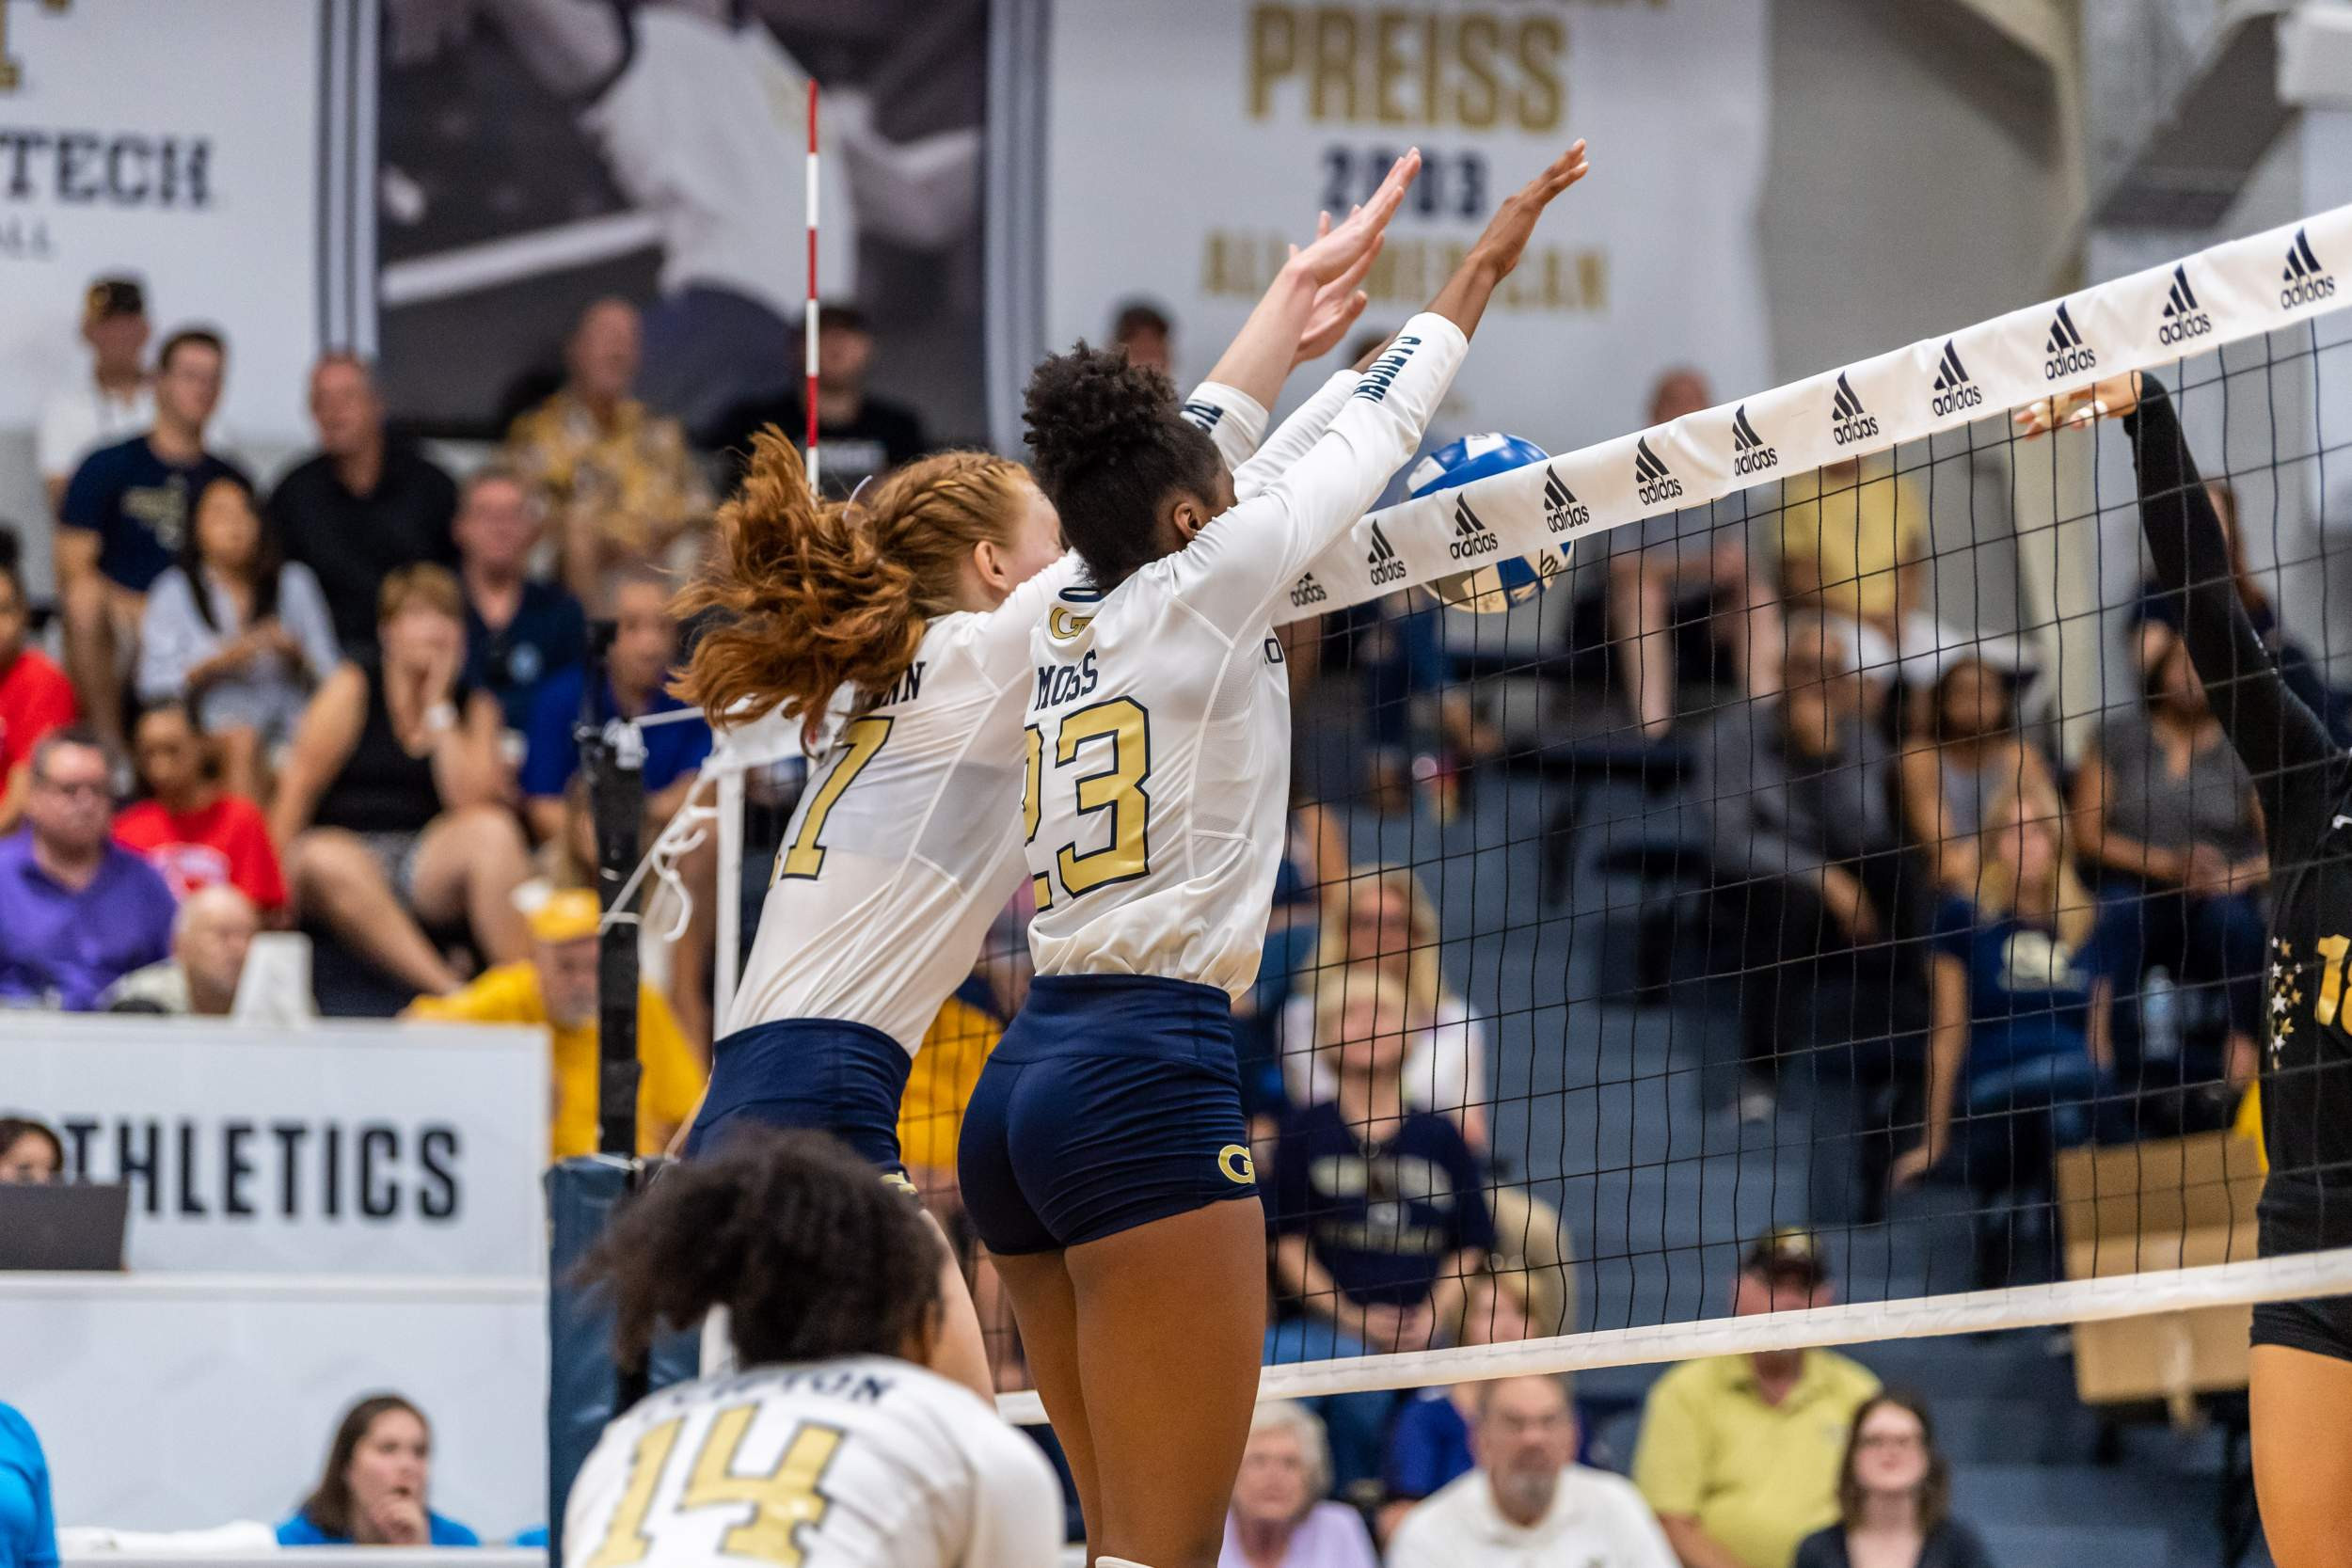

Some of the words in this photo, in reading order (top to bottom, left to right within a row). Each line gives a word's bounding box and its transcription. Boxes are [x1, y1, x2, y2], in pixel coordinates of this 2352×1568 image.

[1247, 4, 1567, 134] PREISS
[0, 130, 212, 209] TECH
[2280, 272, 2335, 310] adidas
[2159, 310, 2212, 346] adidas
[2044, 345, 2097, 381] adidas
[1932, 383, 1983, 417] adidas
[1834, 414, 1880, 447] adidas
[1734, 446, 1778, 477] adidas
[1639, 476, 1683, 506] adidas
[1547, 503, 1590, 533] adidas
[1449, 531, 1499, 560] adidas
[1370, 557, 1406, 586] adidas
[1290, 578, 1327, 608] adidas
[1034, 649, 1099, 712] MOSS
[770, 715, 895, 889] 7
[63, 1121, 460, 1220] THLETICS
[583, 1401, 852, 1568] 14
